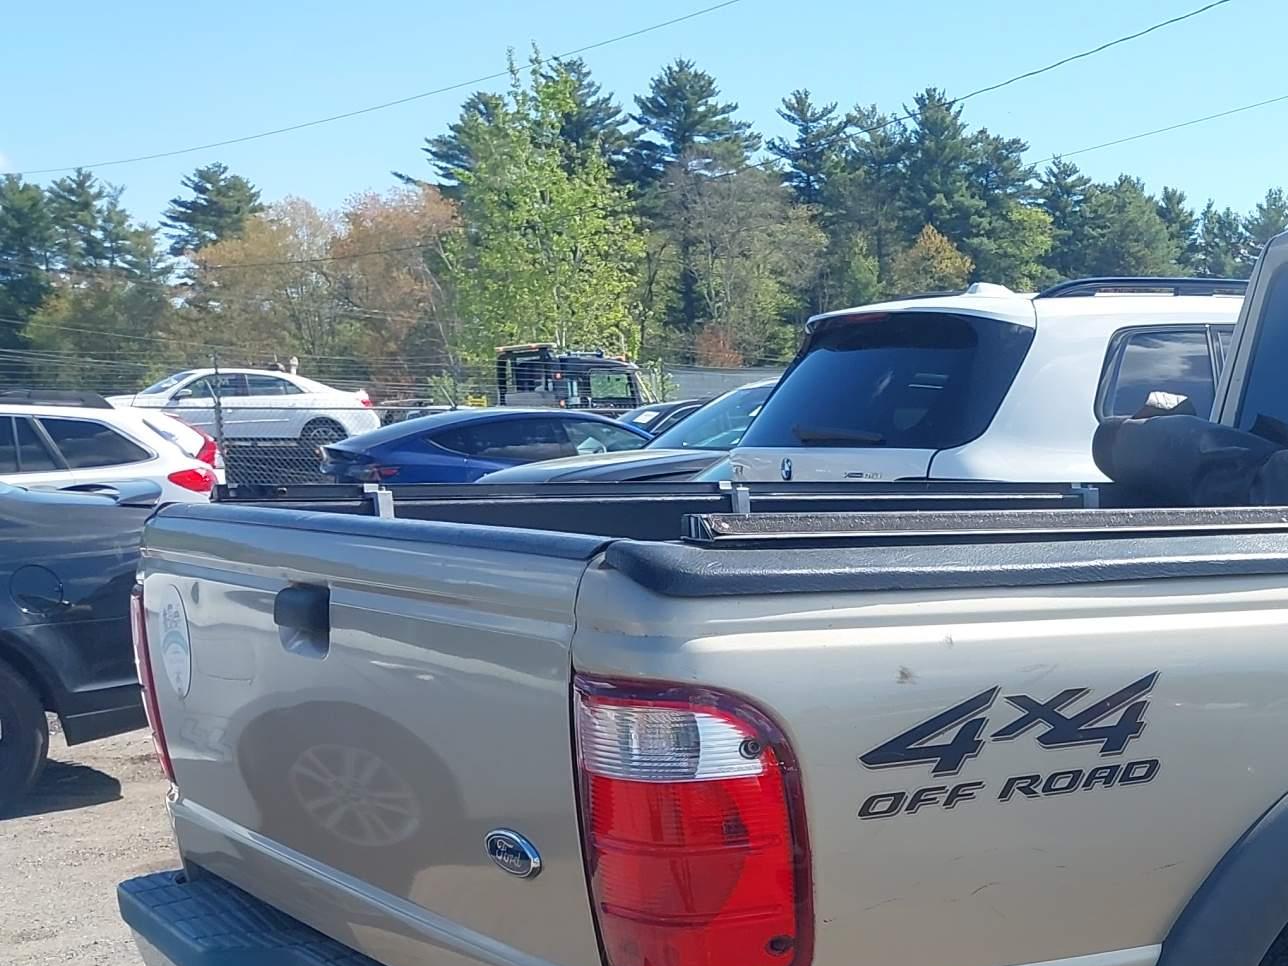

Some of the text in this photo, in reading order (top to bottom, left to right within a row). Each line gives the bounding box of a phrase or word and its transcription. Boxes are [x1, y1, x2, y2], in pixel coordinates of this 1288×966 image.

[857, 758, 1161, 820] OFF ROAD
[495, 839, 522, 868] Ford
